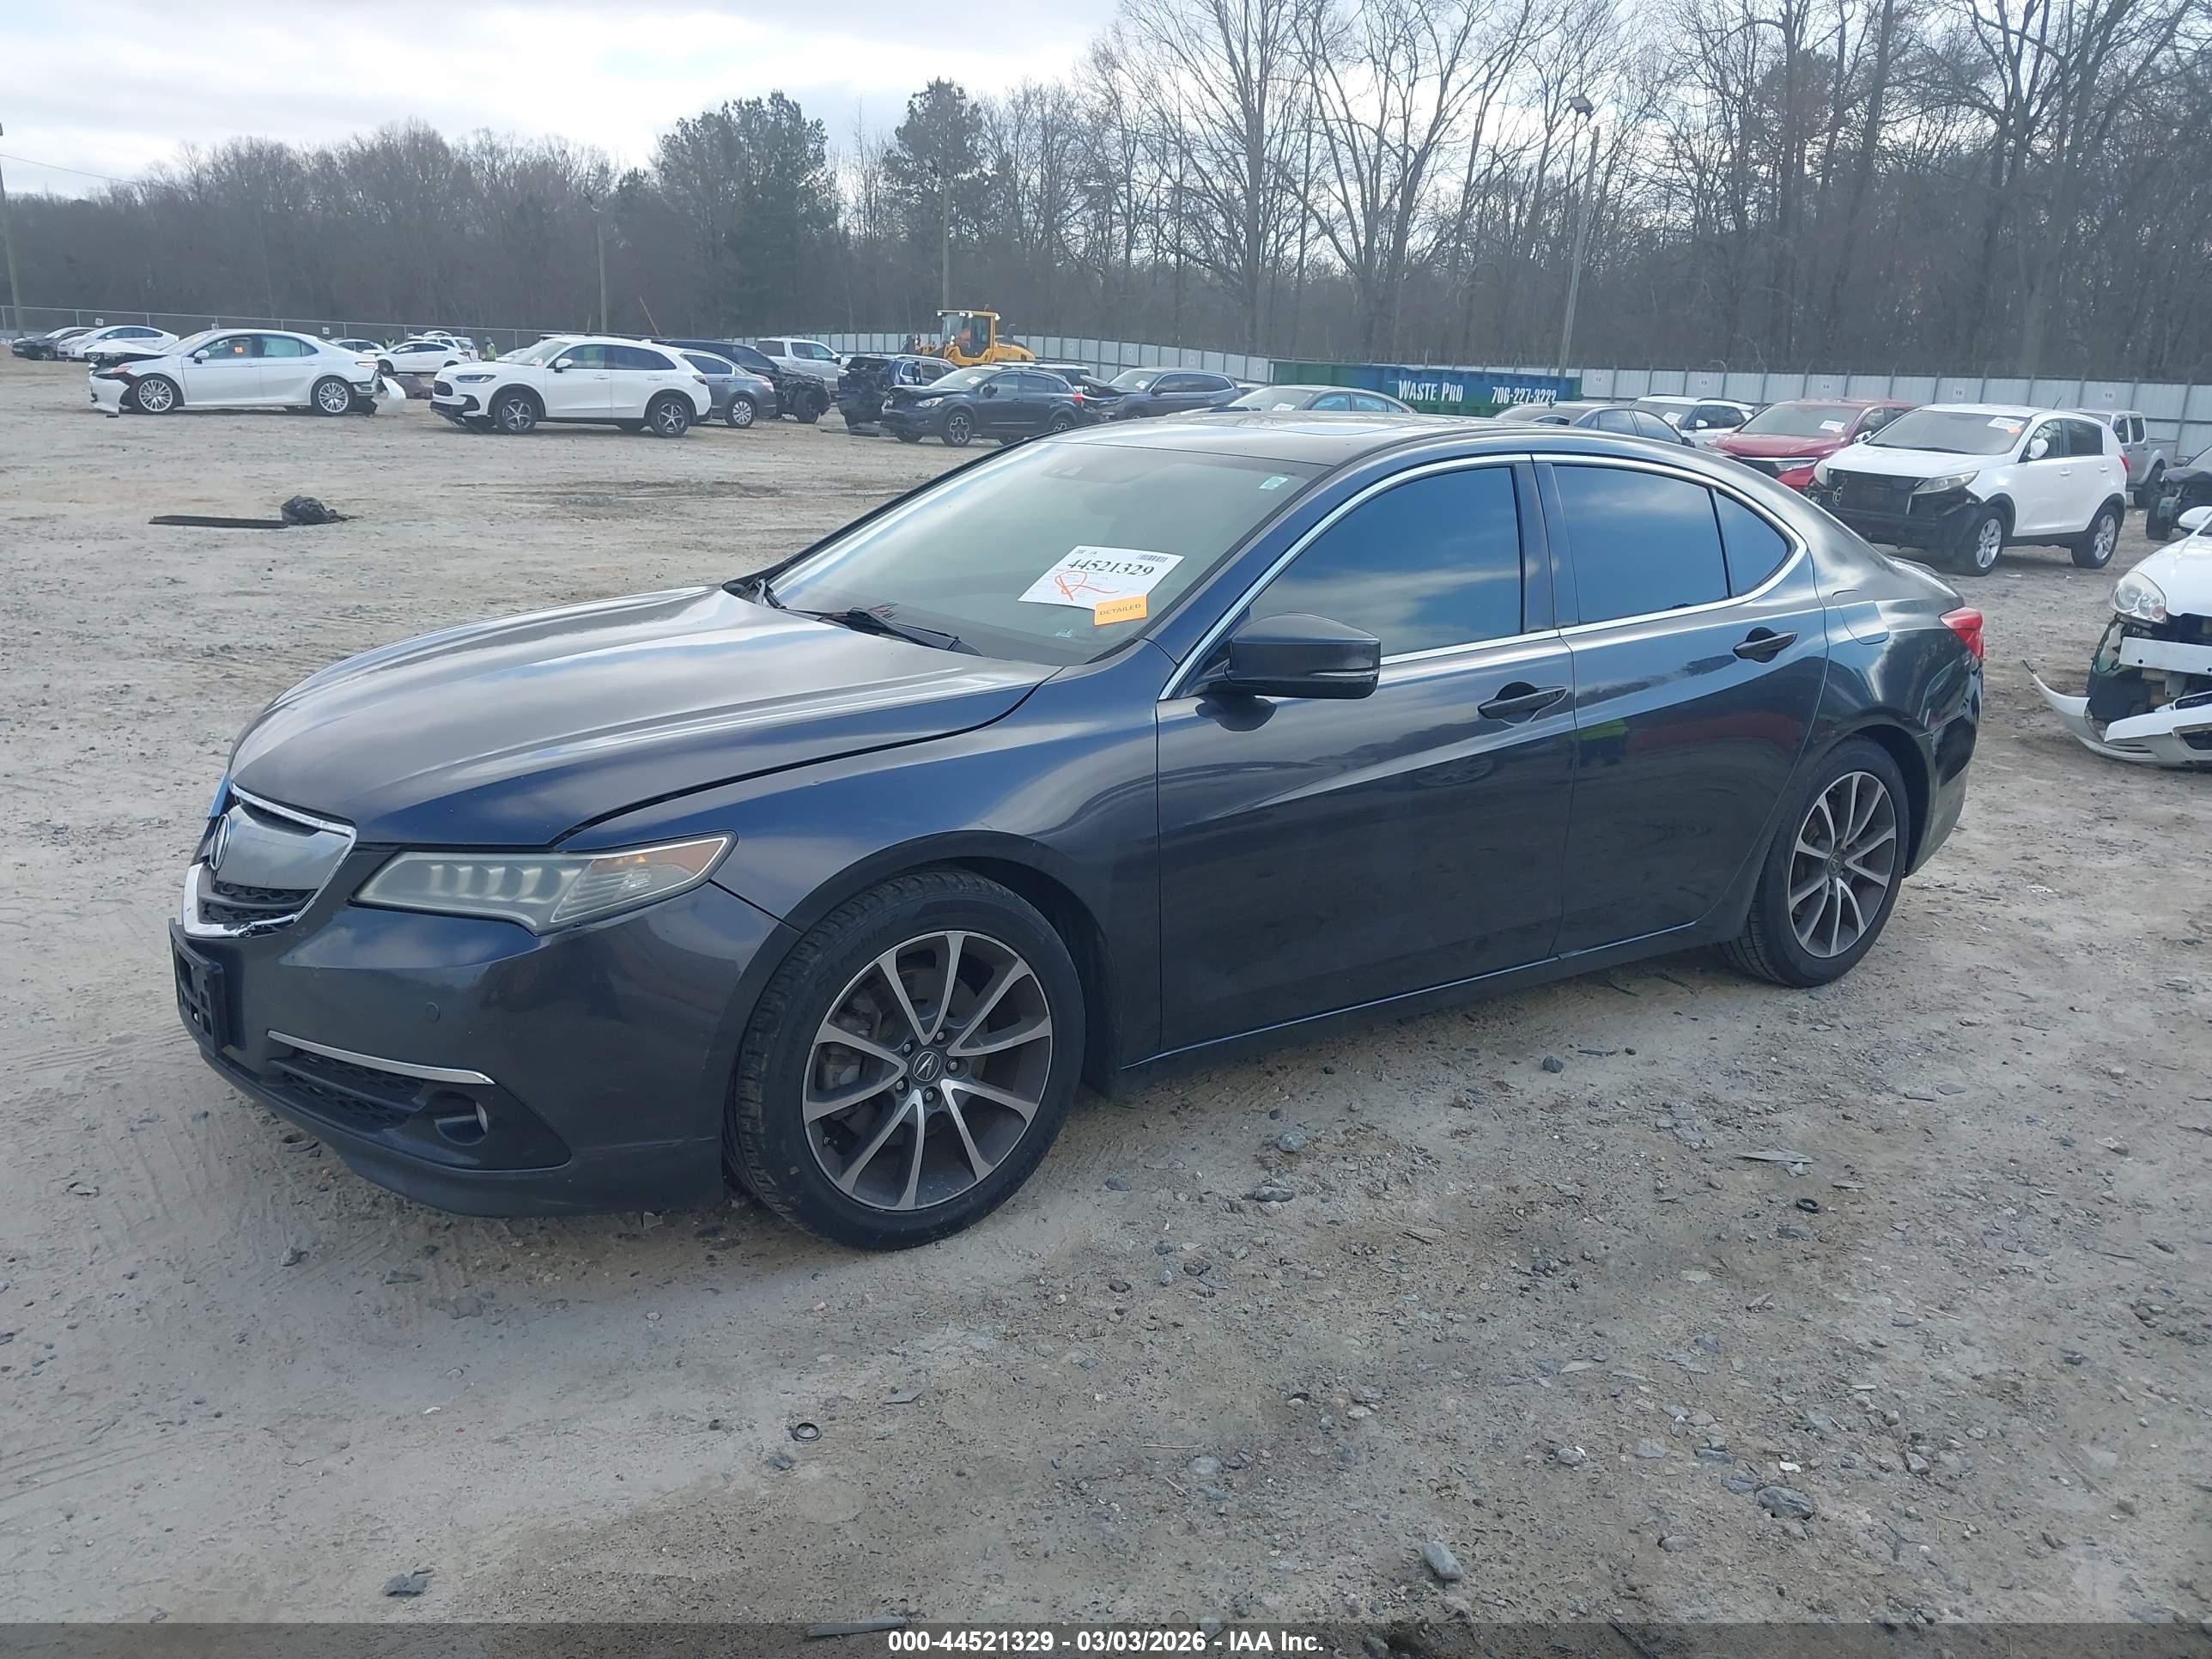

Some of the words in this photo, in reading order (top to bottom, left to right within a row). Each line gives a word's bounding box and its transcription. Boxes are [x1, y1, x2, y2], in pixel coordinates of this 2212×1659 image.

[1492, 386, 1557, 404] 706-227-3222
[1066, 559, 1155, 576] 44521329
[1099, 604, 1141, 616] DETAILED
